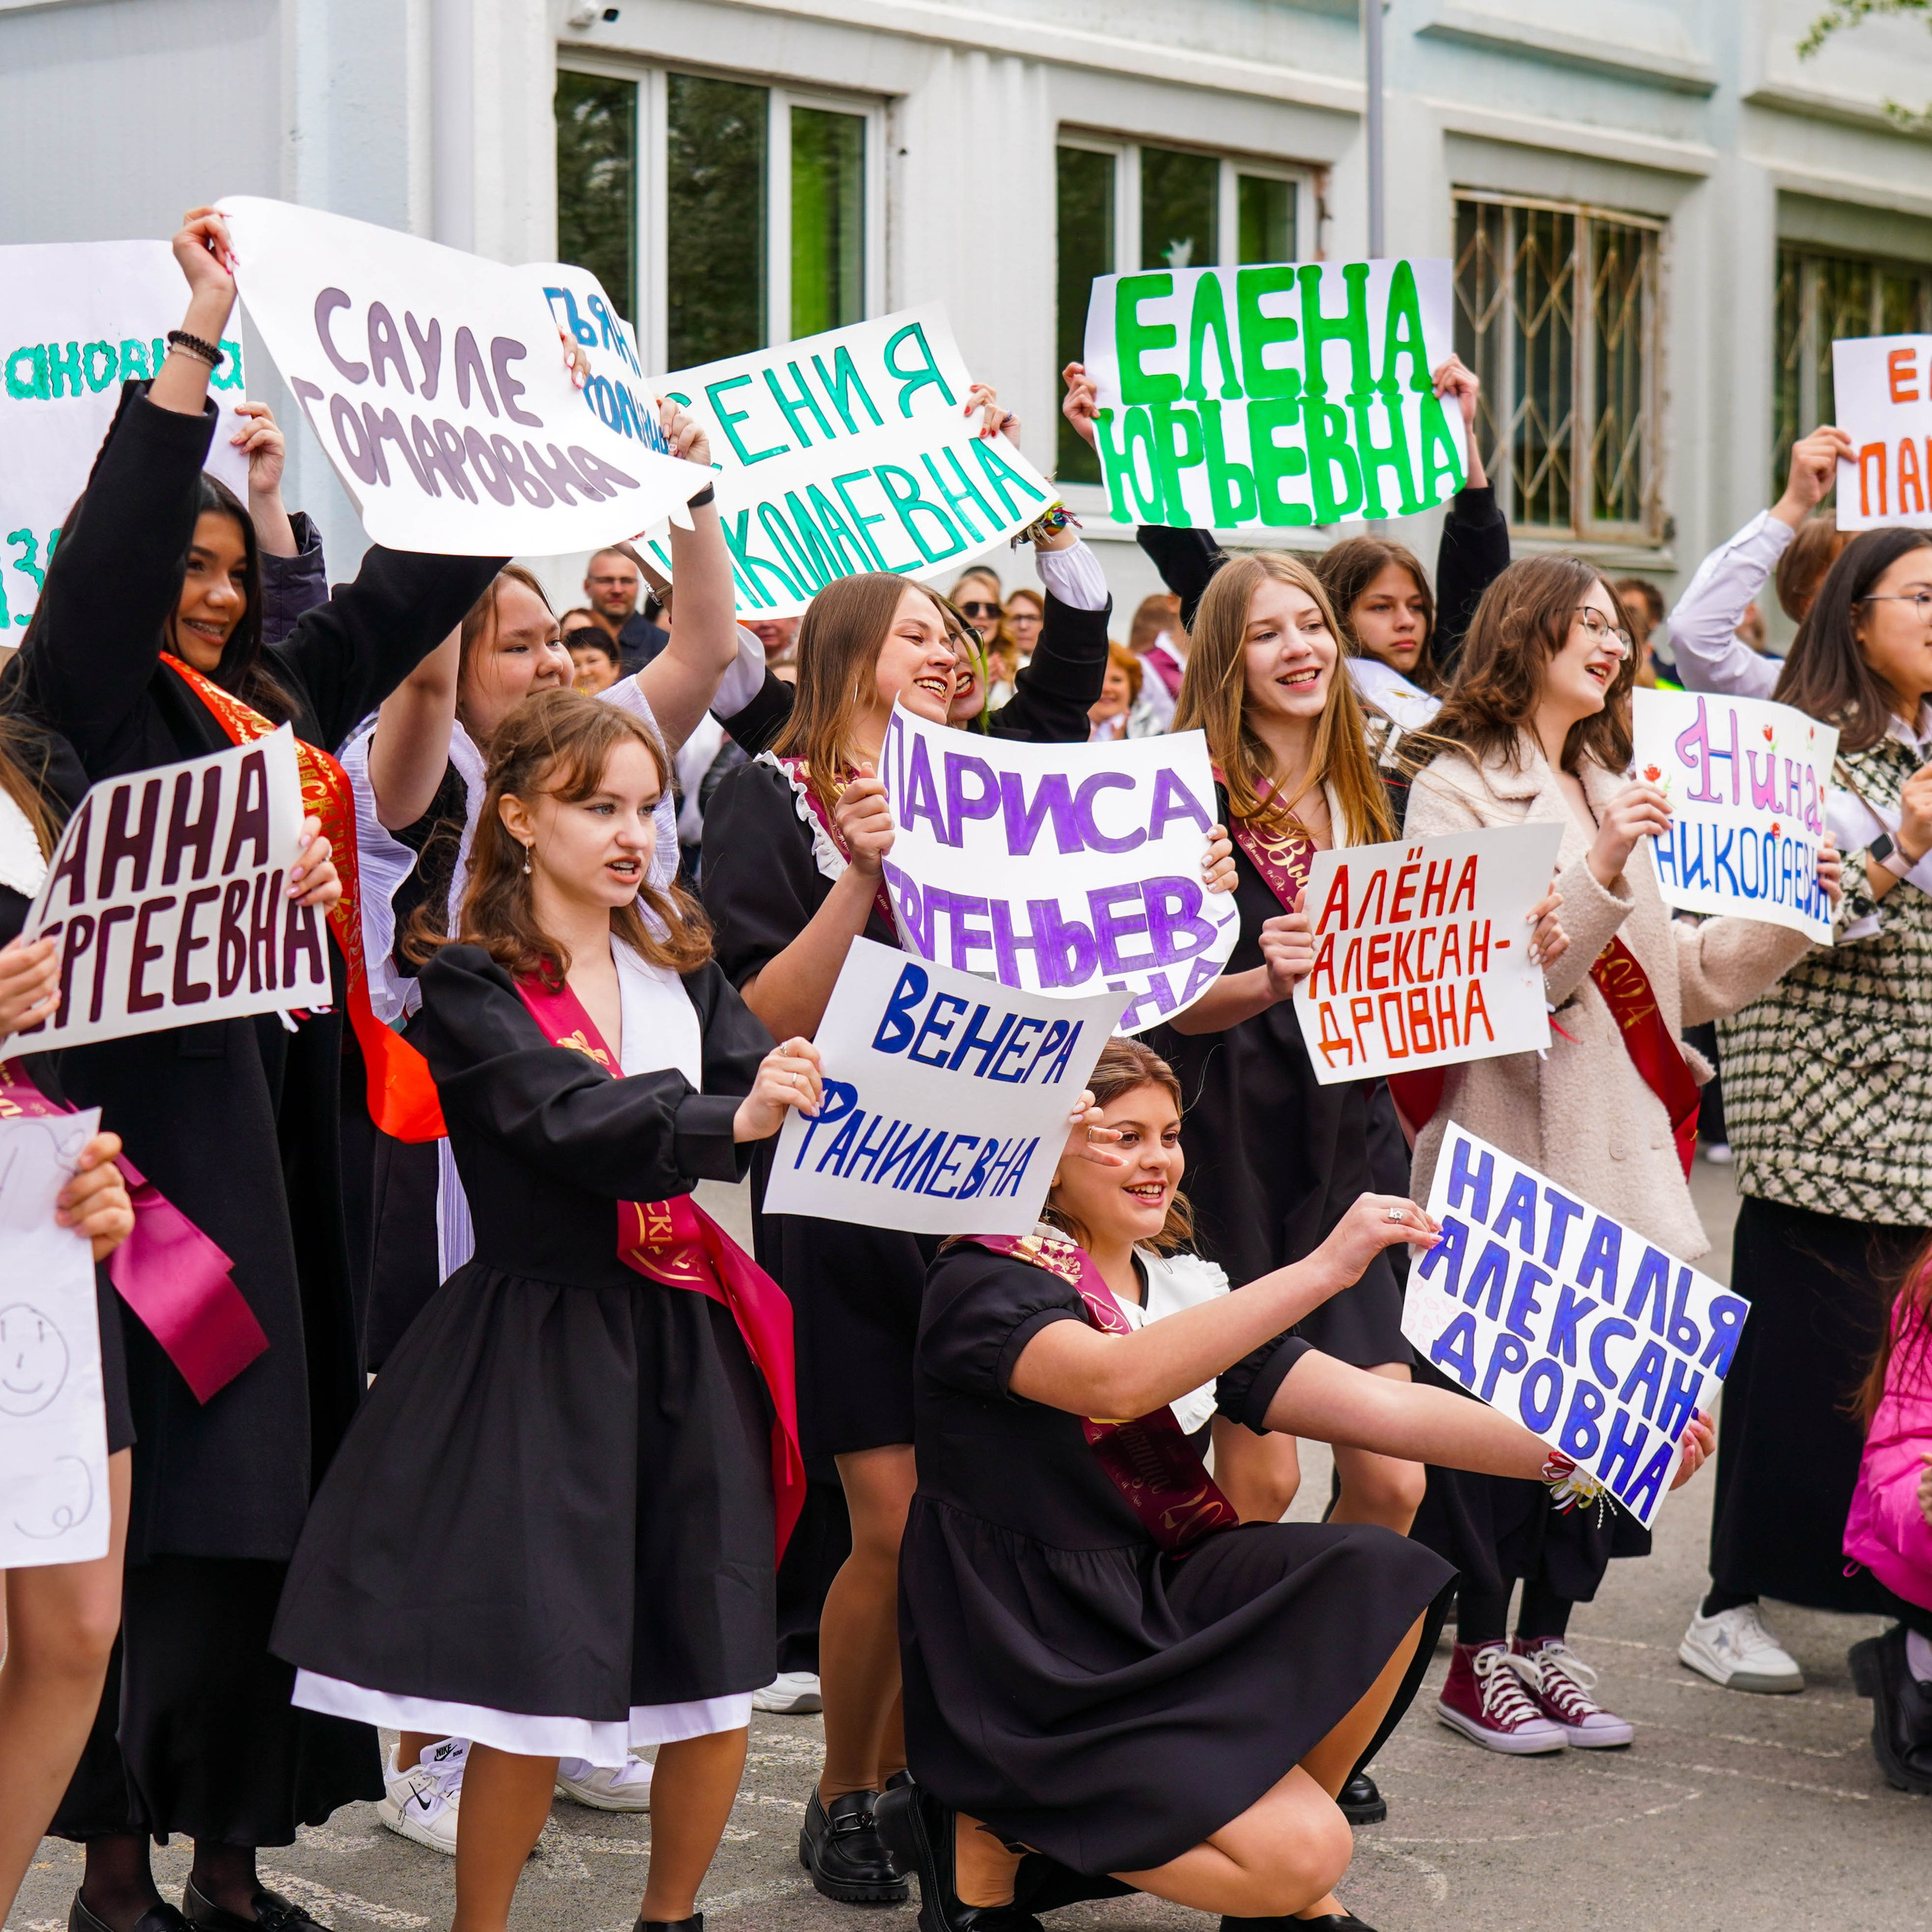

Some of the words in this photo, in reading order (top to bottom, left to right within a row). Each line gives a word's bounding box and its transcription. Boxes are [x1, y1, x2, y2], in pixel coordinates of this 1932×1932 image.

[315, 287, 544, 428] САУЛЕ
[665, 322, 956, 471] ЕНИЯ
[1115, 260, 1432, 406] ЕЛЕНА
[1888, 348, 1932, 405] Е
[1091, 392, 1466, 529] ЮРЬЕВНА
[1859, 434, 1932, 517] ПА
[883, 711, 1213, 857] ЛАРИСА
[1675, 695, 1823, 836] Нина
[40, 750, 269, 925] АННА
[1315, 848, 1478, 934] АЛЁНА
[19, 869, 325, 1037] РГЕЕВНА
[872, 961, 1085, 1084] ВЕНЕРА
[1309, 919, 1510, 1000] АЛЕКСАН-
[1318, 980, 1495, 1069] ДРОВНА
[794, 1077, 1041, 1200] ФАНИЛЕВНА
[1446, 1137, 1749, 1380] НАТАЛЬЯ
[1430, 1311, 1676, 1524] ДРОВНА
[435, 1743, 452, 1758] NIKE
